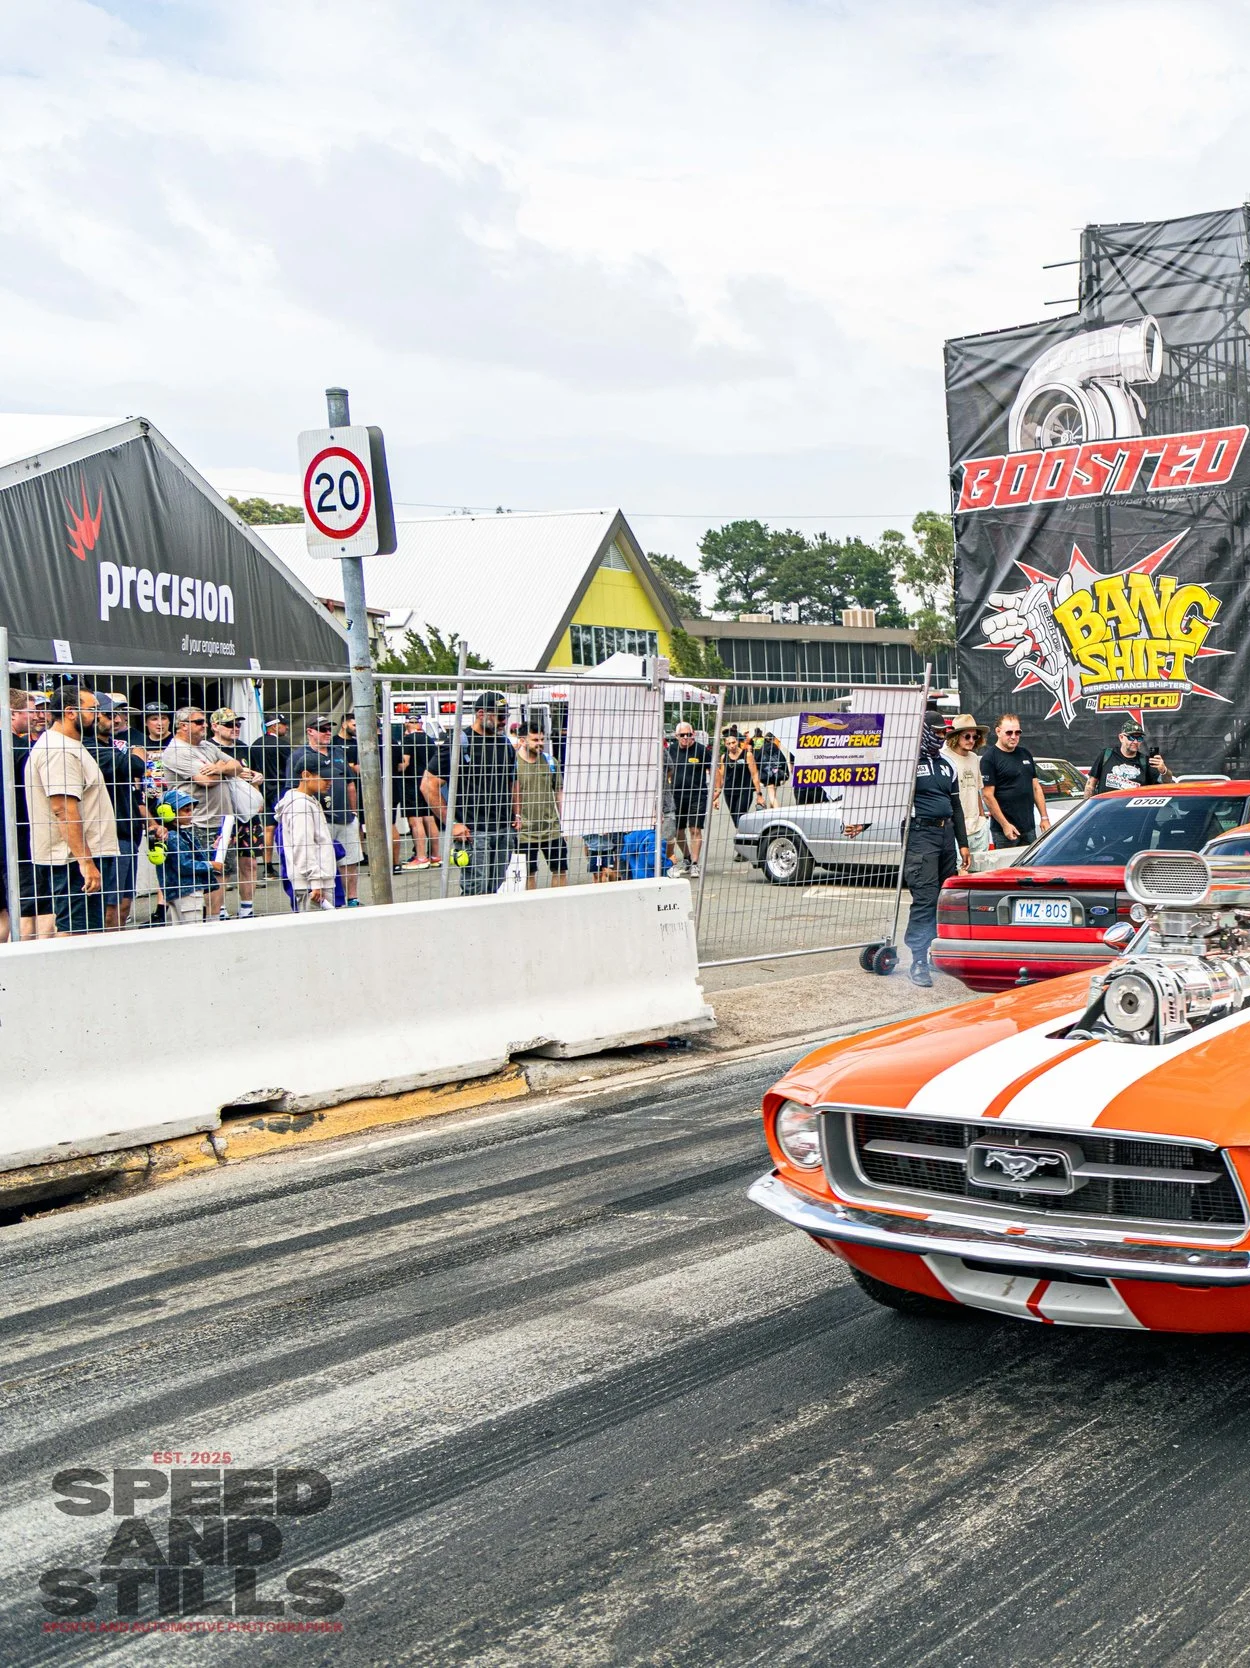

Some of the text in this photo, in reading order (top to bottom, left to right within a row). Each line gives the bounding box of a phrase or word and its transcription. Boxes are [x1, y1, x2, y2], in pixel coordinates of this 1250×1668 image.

[958, 427, 1246, 511] BOOSTED
[315, 470, 360, 513] 20
[100, 561, 235, 624] precision
[1040, 602, 1063, 652] AEROFLOW
[1054, 572, 1222, 658] BANG
[181, 634, 236, 657] all your engine needs
[1076, 640, 1199, 685] SHIFT
[1084, 680, 1191, 692] PERFORMANCE SHIFTERS
[1099, 693, 1180, 710] AEROFLOW
[799, 734, 880, 747] 1300TEMPFENCE
[796, 767, 876, 784] 1300 836 733
